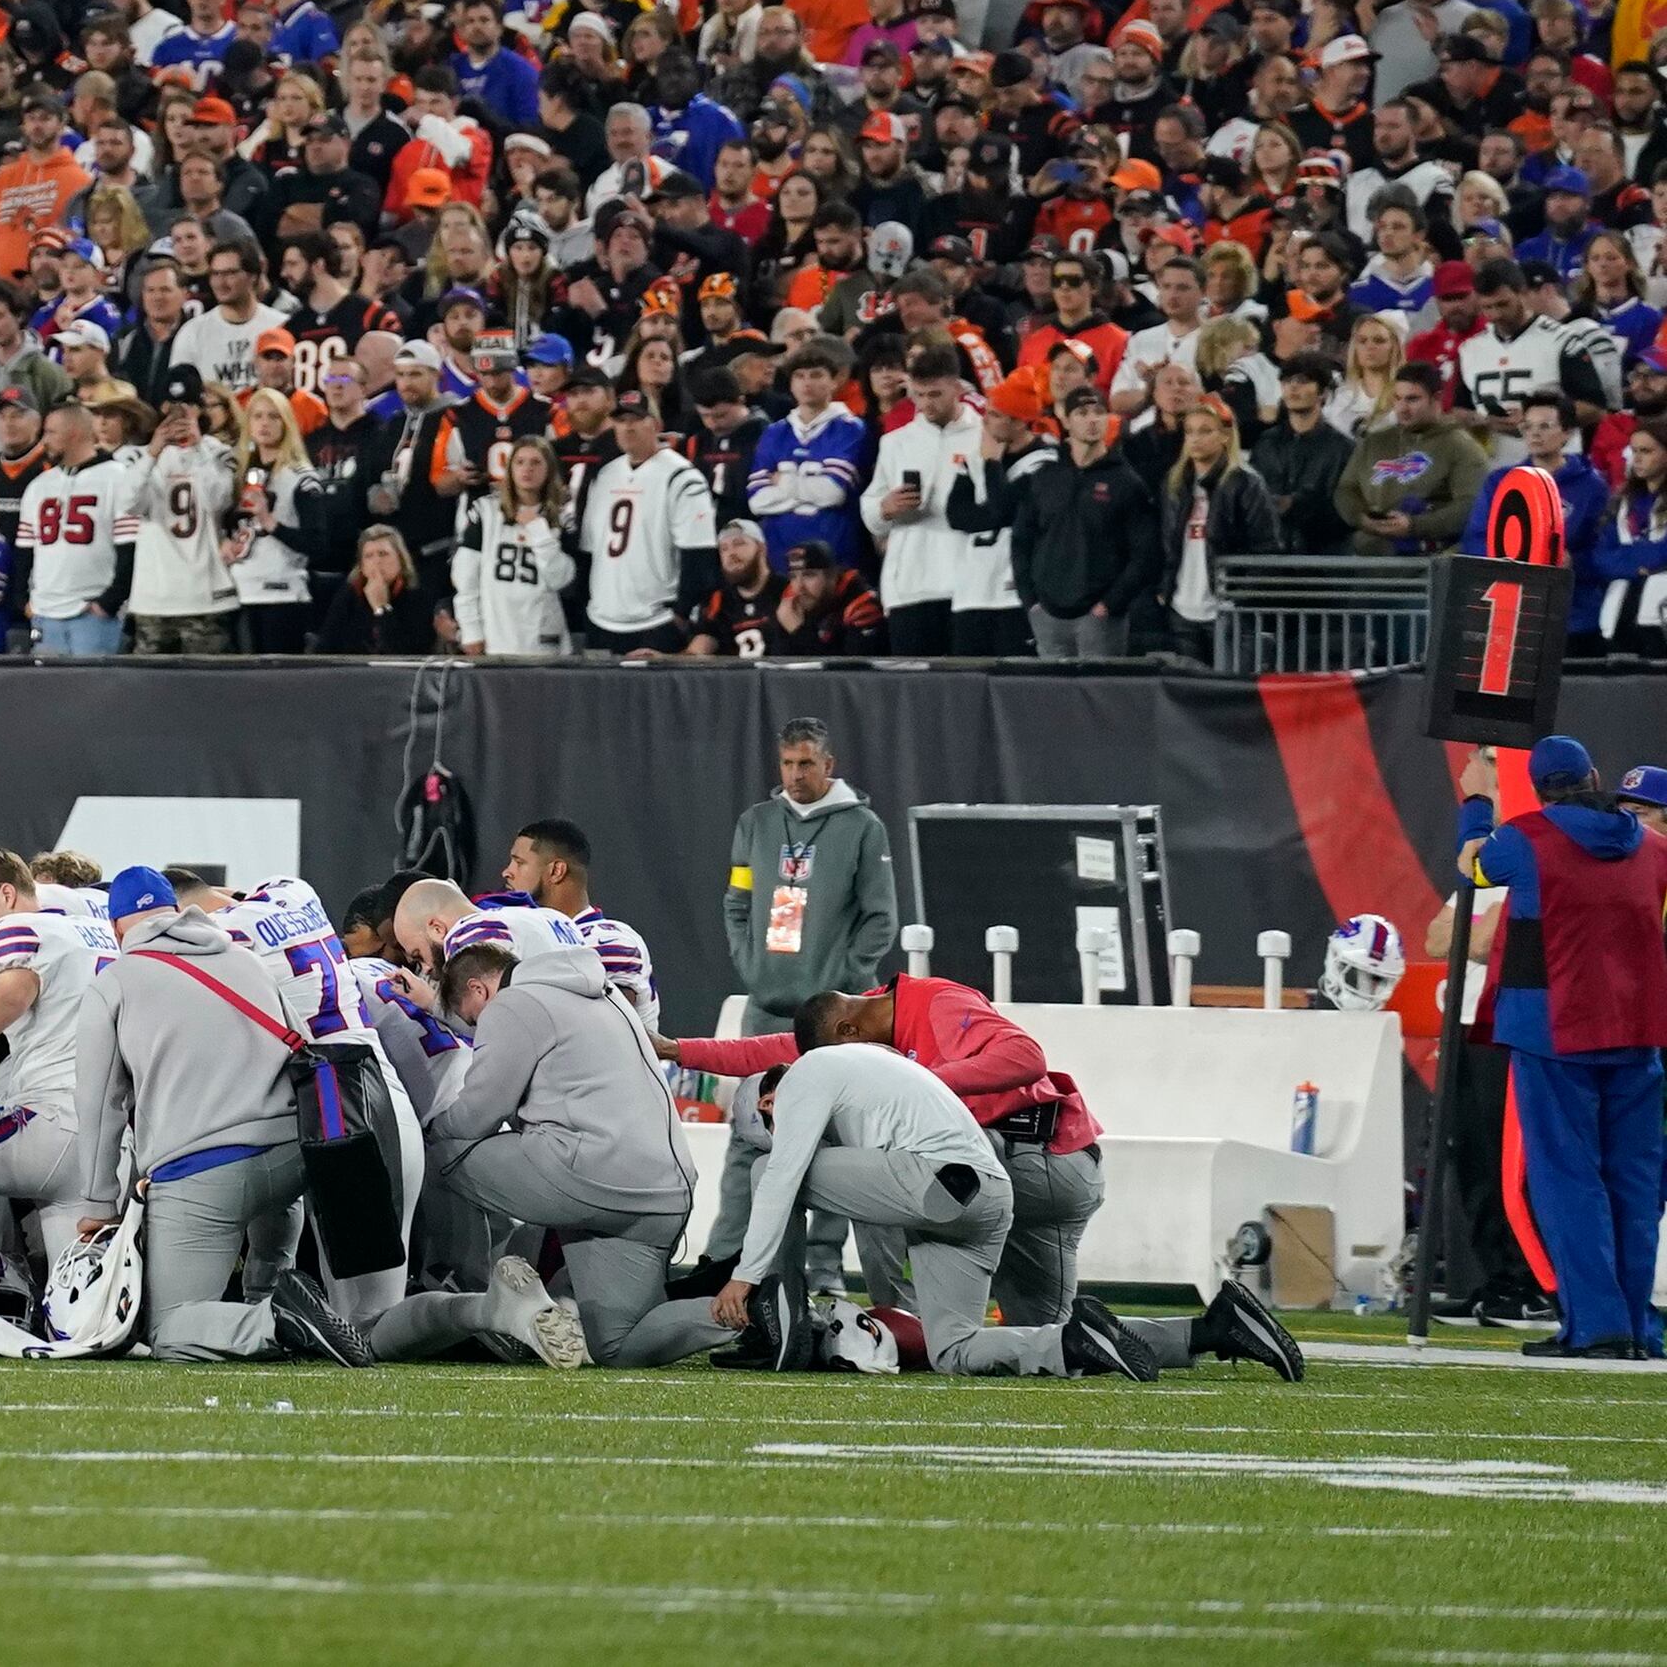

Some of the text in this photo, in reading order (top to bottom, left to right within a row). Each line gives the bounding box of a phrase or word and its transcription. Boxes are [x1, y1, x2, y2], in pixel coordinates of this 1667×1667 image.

[38, 496, 98, 544] 85
[170, 482, 196, 538] 9
[608, 500, 631, 556] 9
[497, 544, 538, 584] 85
[1479, 580, 1524, 696] 1
[76, 925, 118, 951] BASS
